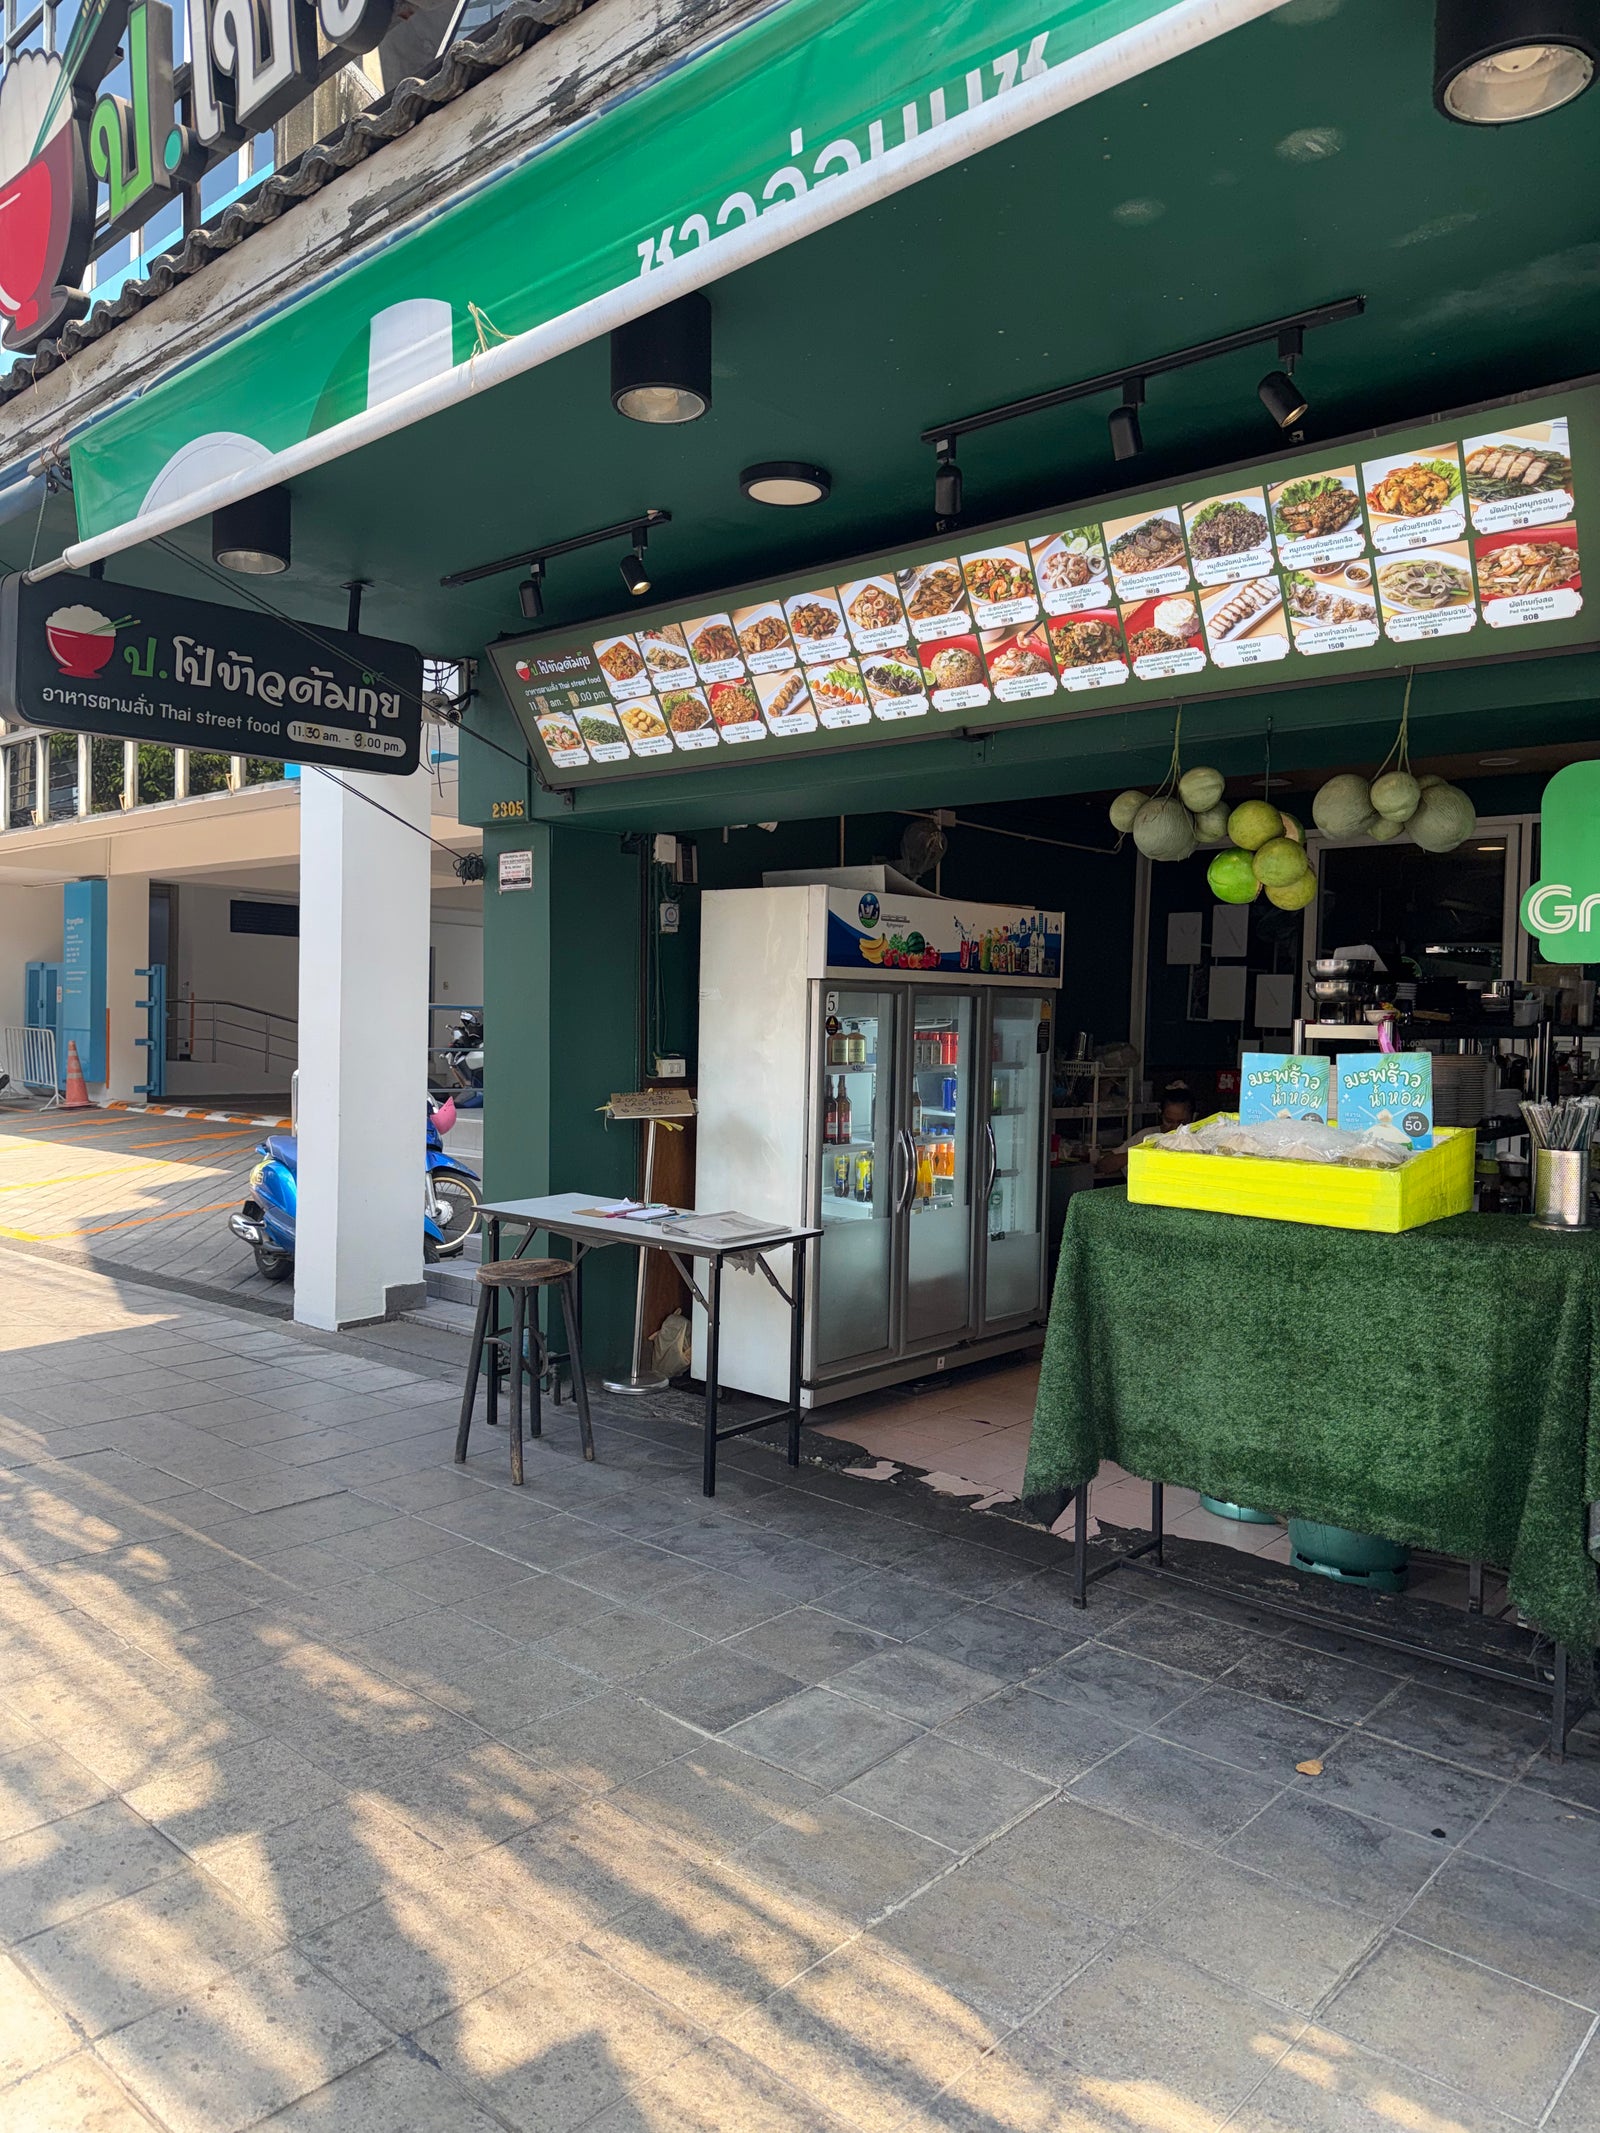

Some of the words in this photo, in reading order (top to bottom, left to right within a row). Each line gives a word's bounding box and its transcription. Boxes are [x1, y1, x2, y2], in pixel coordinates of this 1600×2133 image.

[1489, 496, 1554, 516] ผัดผักบุ้งหมูกรอบ
[1530, 506, 1542, 514] with
[1508, 596, 1554, 609] ผัดไทยกุ้งสด
[1236, 642, 1260, 651] หมูกรอบ
[559, 682, 570, 690] Thai
[571, 679, 587, 688] street
[587, 675, 601, 684] food
[42, 684, 155, 718] อาหารตามสั่ง
[159, 702, 192, 723] Thai
[196, 710, 242, 730] street
[246, 715, 281, 736] food
[322, 732, 342, 744] am.
[383, 740, 402, 754] pm.
[491, 799, 524, 818] 2305
[827, 993, 837, 1013] 5
[1247, 1063, 1321, 1091] มะพร้าว
[1343, 1061, 1422, 1089] มะพร้าว
[1271, 1084, 1323, 1109] น้ำหอม
[1368, 1084, 1426, 1109] น้ำหอม
